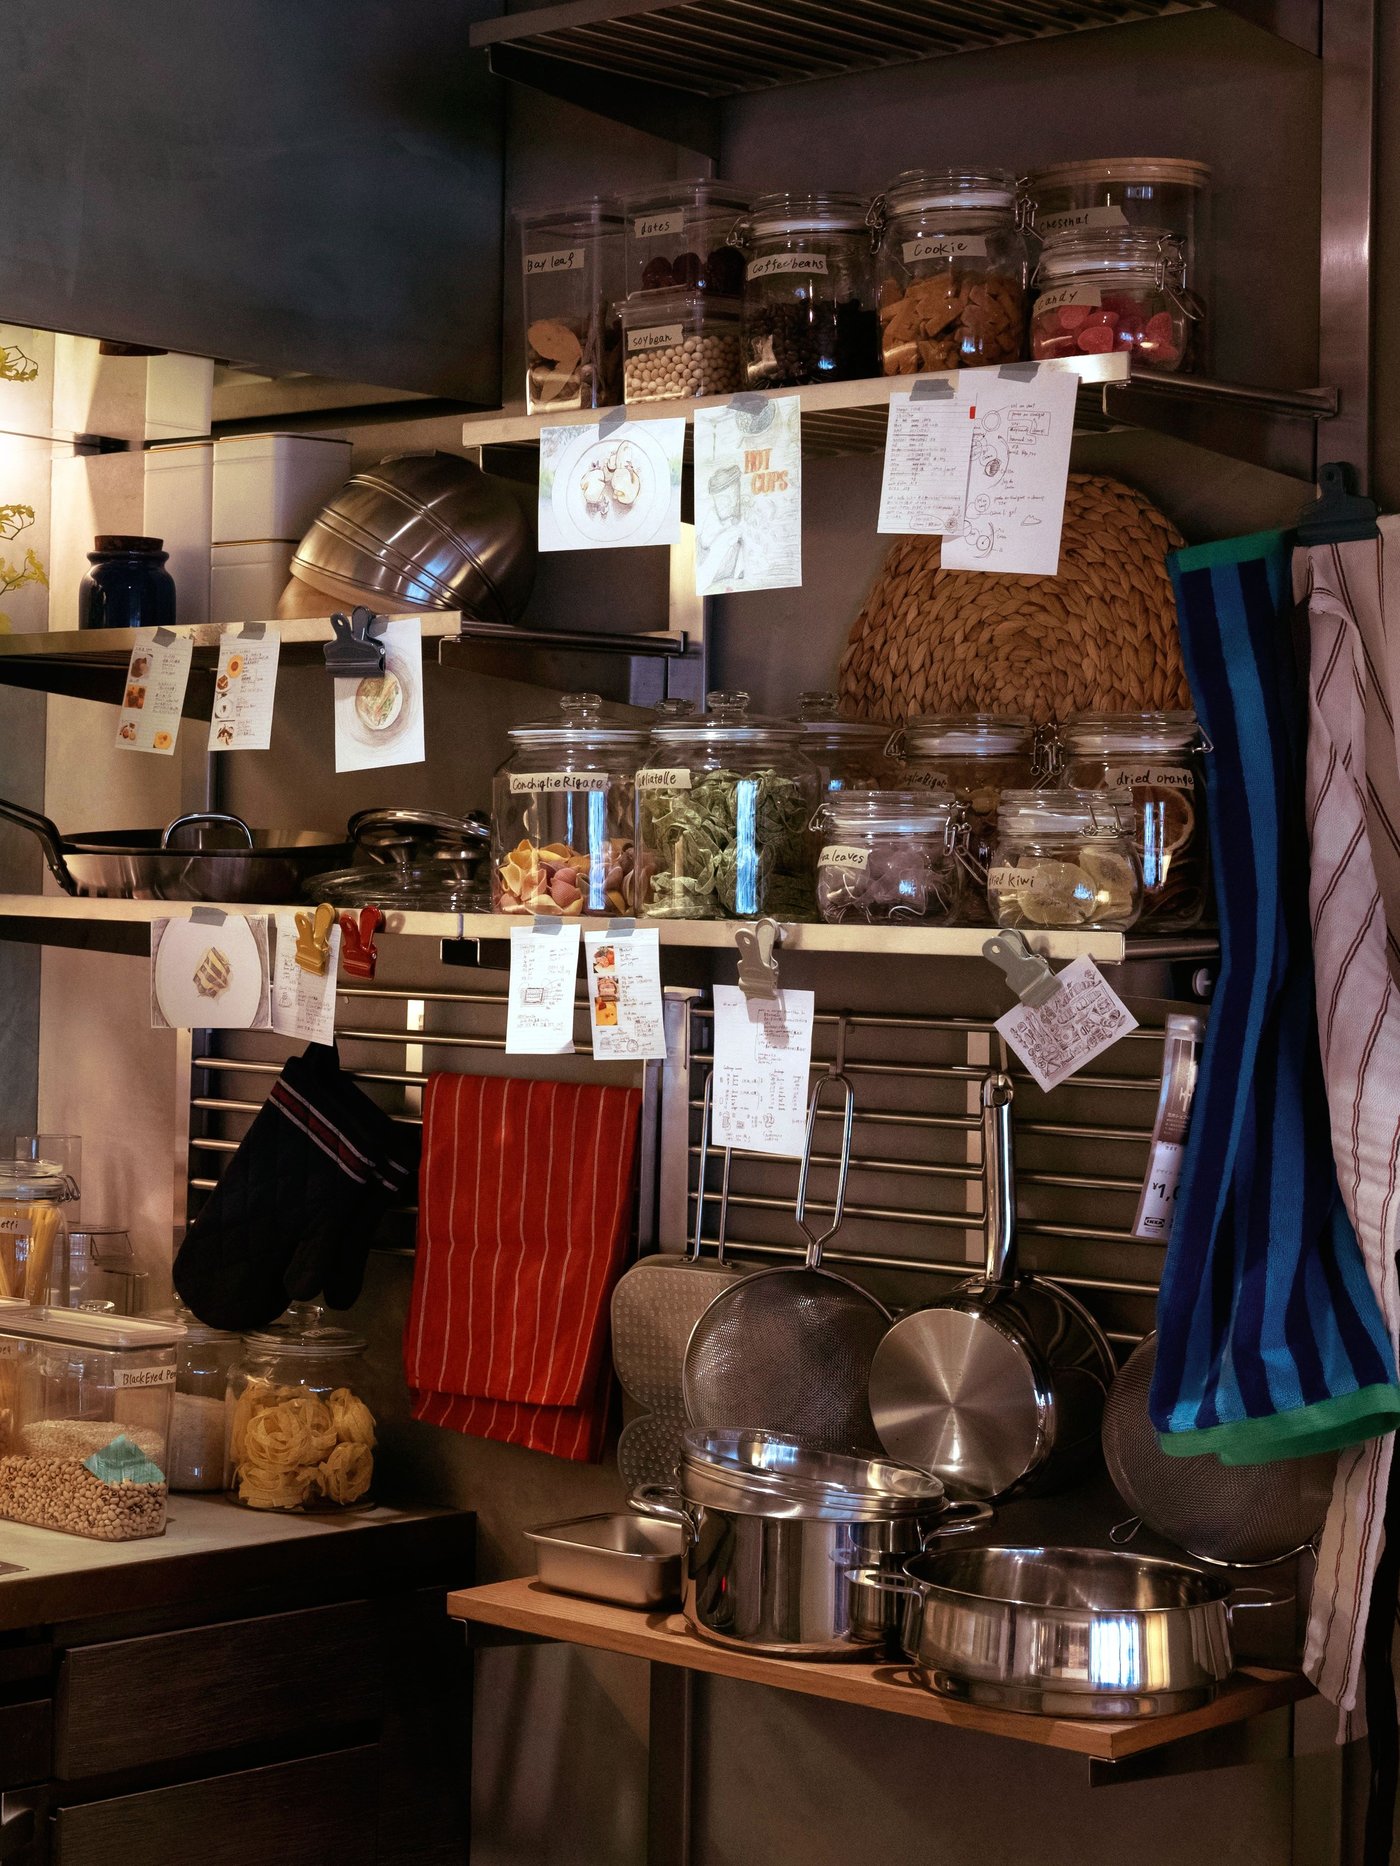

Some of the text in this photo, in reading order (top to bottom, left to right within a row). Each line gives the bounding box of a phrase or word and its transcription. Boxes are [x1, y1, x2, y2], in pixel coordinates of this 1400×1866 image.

[641, 221, 670, 235] dates
[914, 242, 968, 257] Cookie
[527, 252, 574, 273] Bay leaf
[633, 333, 672, 347] soybean
[744, 447, 773, 474] HOT
[750, 469, 789, 496] CUPS
[1116, 769, 1194, 787] dried orange
[832, 849, 865, 864] leaves
